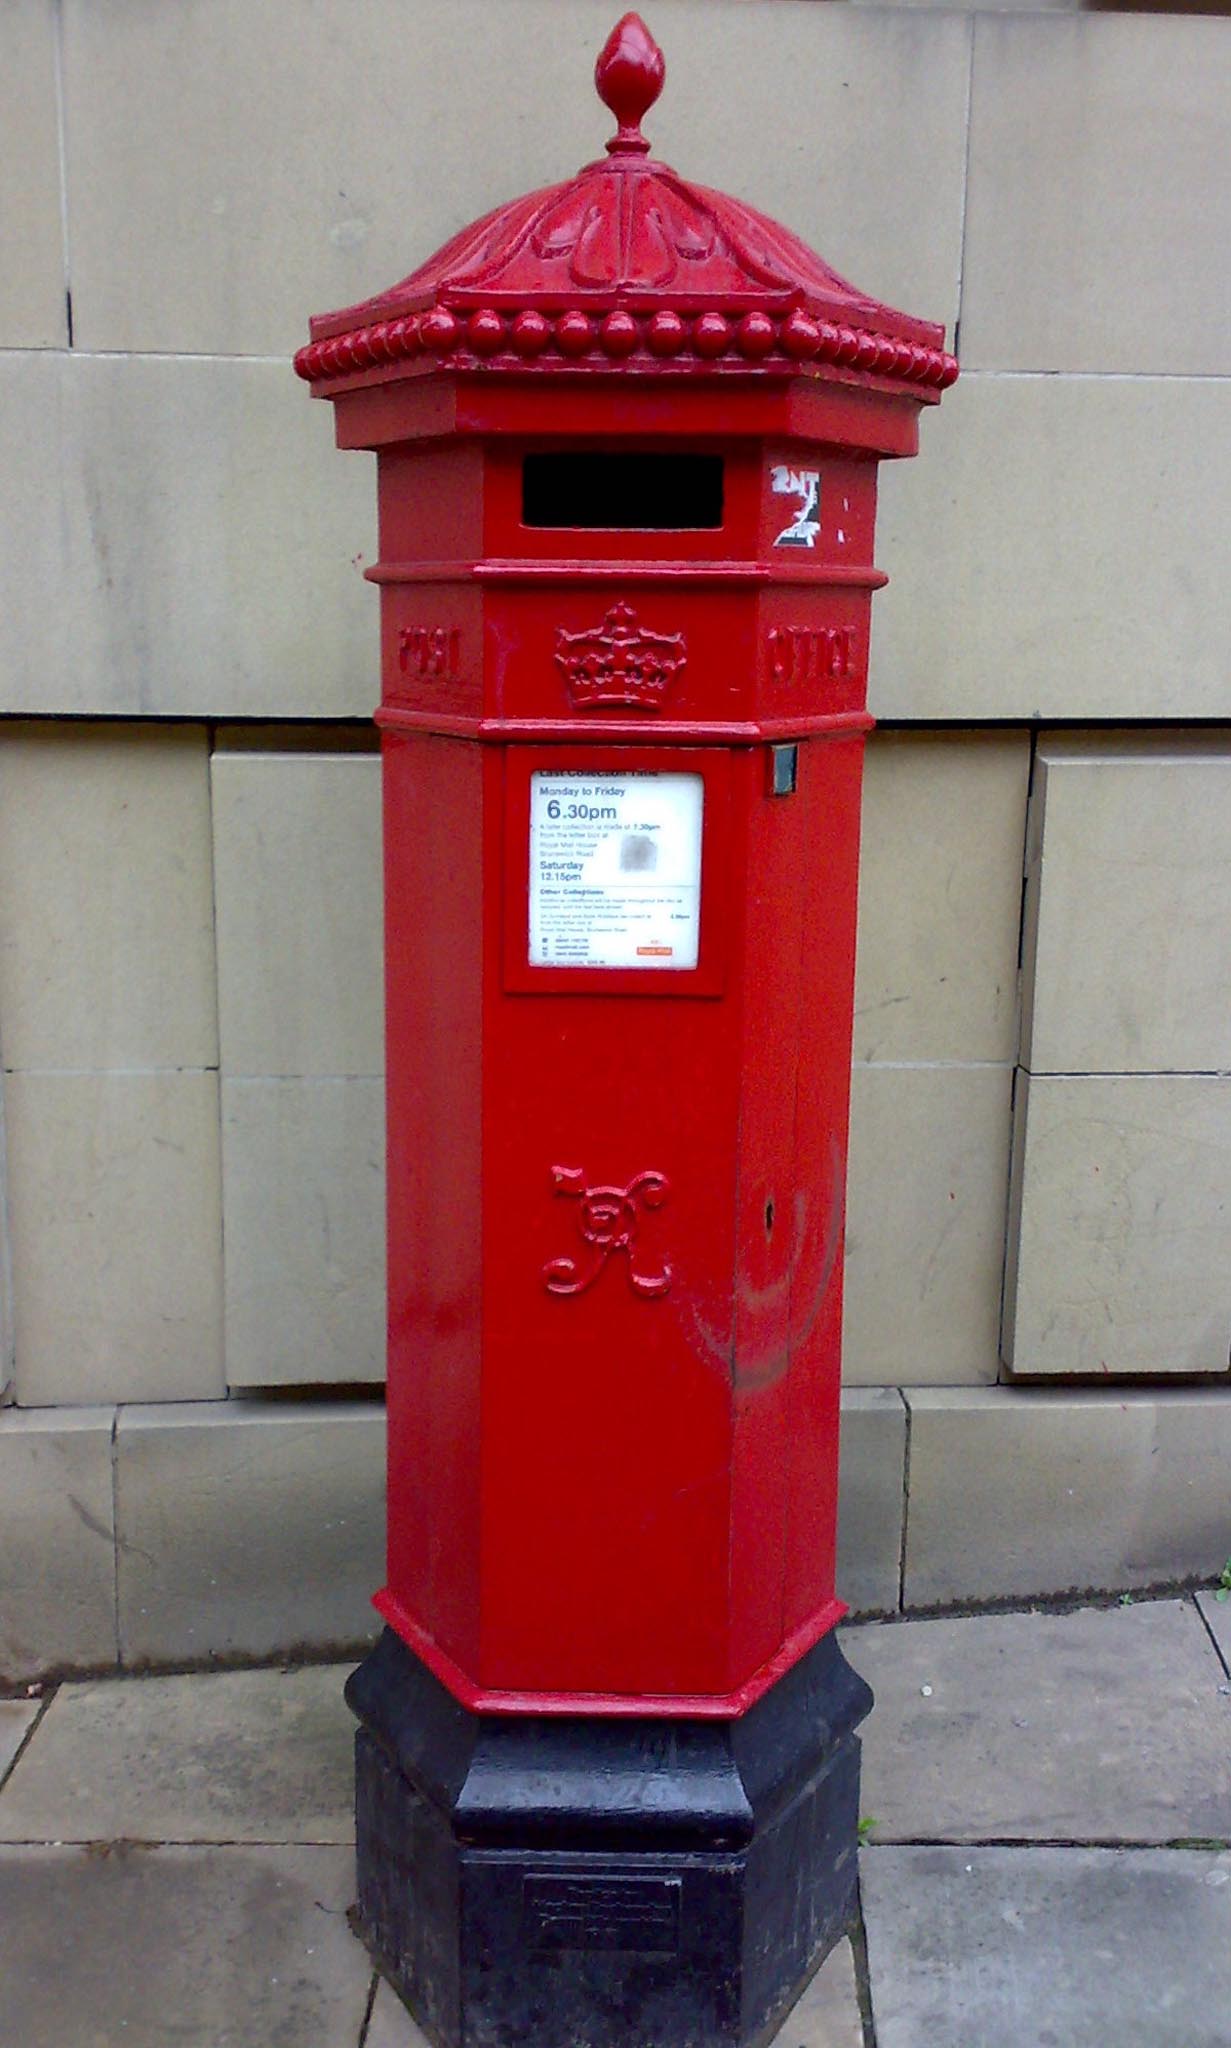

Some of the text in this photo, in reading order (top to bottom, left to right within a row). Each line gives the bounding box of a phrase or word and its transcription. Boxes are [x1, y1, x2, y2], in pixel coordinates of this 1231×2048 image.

[540, 786, 626, 797] Monday to Friday
[547, 799, 617, 821] 6.30pm
[540, 861, 584, 871] Saturday
[541, 872, 582, 882] 12.15pm
